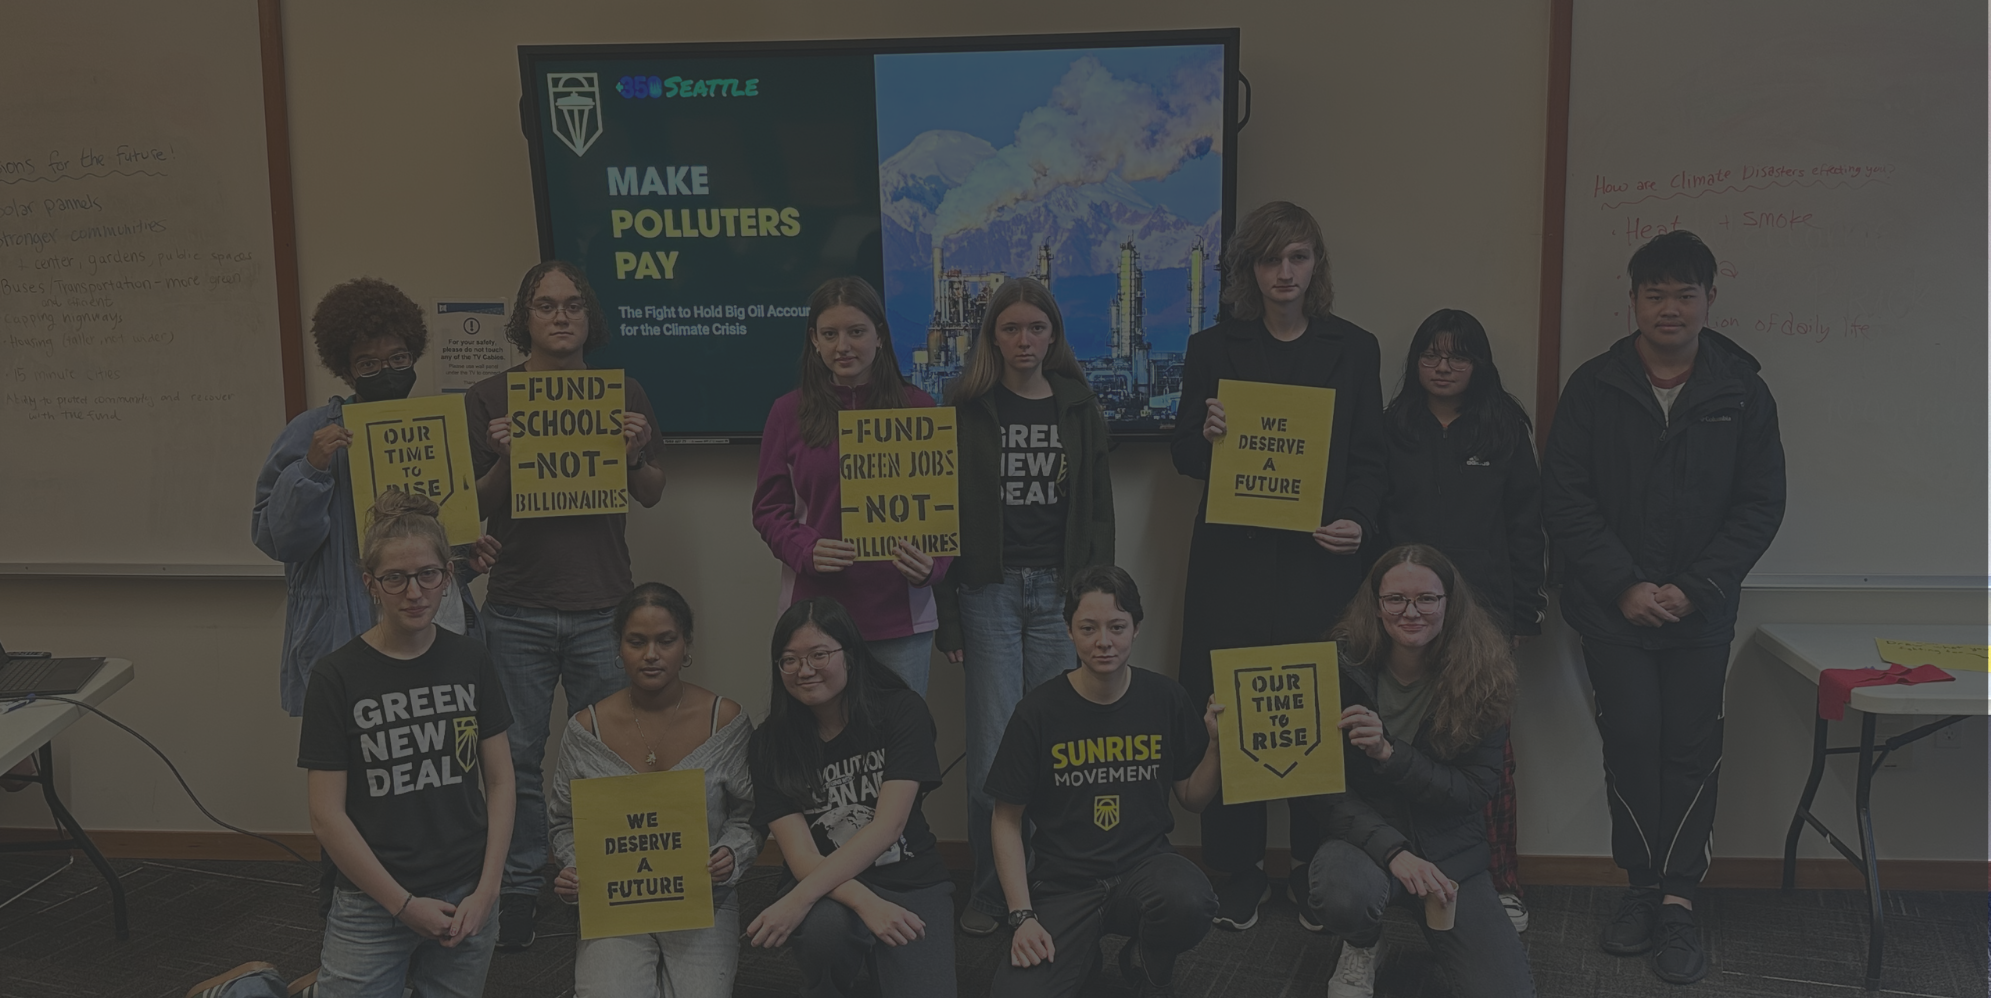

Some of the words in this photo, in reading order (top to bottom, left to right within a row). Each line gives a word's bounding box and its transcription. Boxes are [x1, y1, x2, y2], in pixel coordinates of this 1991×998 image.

[619, 75, 662, 98] 350
[664, 76, 759, 98] SEATTLE
[49, 150, 70, 174] for
[80, 148, 105, 167] the
[607, 165, 710, 196] MAKE
[1594, 174, 1628, 198] How
[1636, 179, 1658, 192] are
[1670, 170, 1731, 189] Climate
[1742, 164, 1806, 181] Disasters
[44, 194, 103, 217] pannels
[71, 219, 167, 241] communities
[611, 207, 801, 239] POLLUTERS
[1626, 215, 1682, 246] Heat
[157, 248, 201, 267] public
[615, 251, 680, 280] PAY
[165, 275, 200, 289] more
[619, 305, 642, 318] The
[644, 305, 675, 320] Fight
[677, 306, 691, 318] to
[693, 304, 722, 318] Hold
[725, 304, 745, 320] Big
[747, 304, 765, 318] Oil
[620, 323, 637, 336] for
[639, 323, 661, 336] the
[663, 322, 710, 336] Climate
[712, 322, 747, 336] Crisis
[1755, 312, 1778, 334] of
[1780, 311, 1830, 344] daily
[1843, 314, 1871, 339] life
[442, 346, 462, 354] please
[14, 367, 26, 382] 15
[384, 426, 430, 444] OUR
[512, 409, 622, 438] SCHOOLS
[1261, 416, 1287, 432] WE
[384, 445, 435, 464] TIME
[1238, 434, 1305, 455] DESERVE
[402, 466, 422, 478] TO
[840, 452, 900, 480] GREEN
[908, 449, 955, 478] JOBS
[1000, 452, 1056, 477] EW
[1262, 457, 1276, 471] A
[1235, 473, 1301, 495] FUTURE
[516, 488, 628, 512] BILLIONAIRES
[1252, 673, 1300, 693] OUR
[353, 683, 477, 729] GREEN
[1251, 693, 1304, 713] TIME
[1269, 714, 1289, 728] TO
[360, 720, 446, 763] NEW
[1252, 727, 1307, 750] RISE
[1051, 734, 1162, 769] SUNRISE
[366, 755, 462, 797] DEAL
[1054, 764, 1160, 787] MOVEMENT
[626, 812, 659, 829] WE
[605, 832, 682, 855] DESERVE
[637, 857, 653, 873] A
[607, 875, 685, 899] FUTURE
